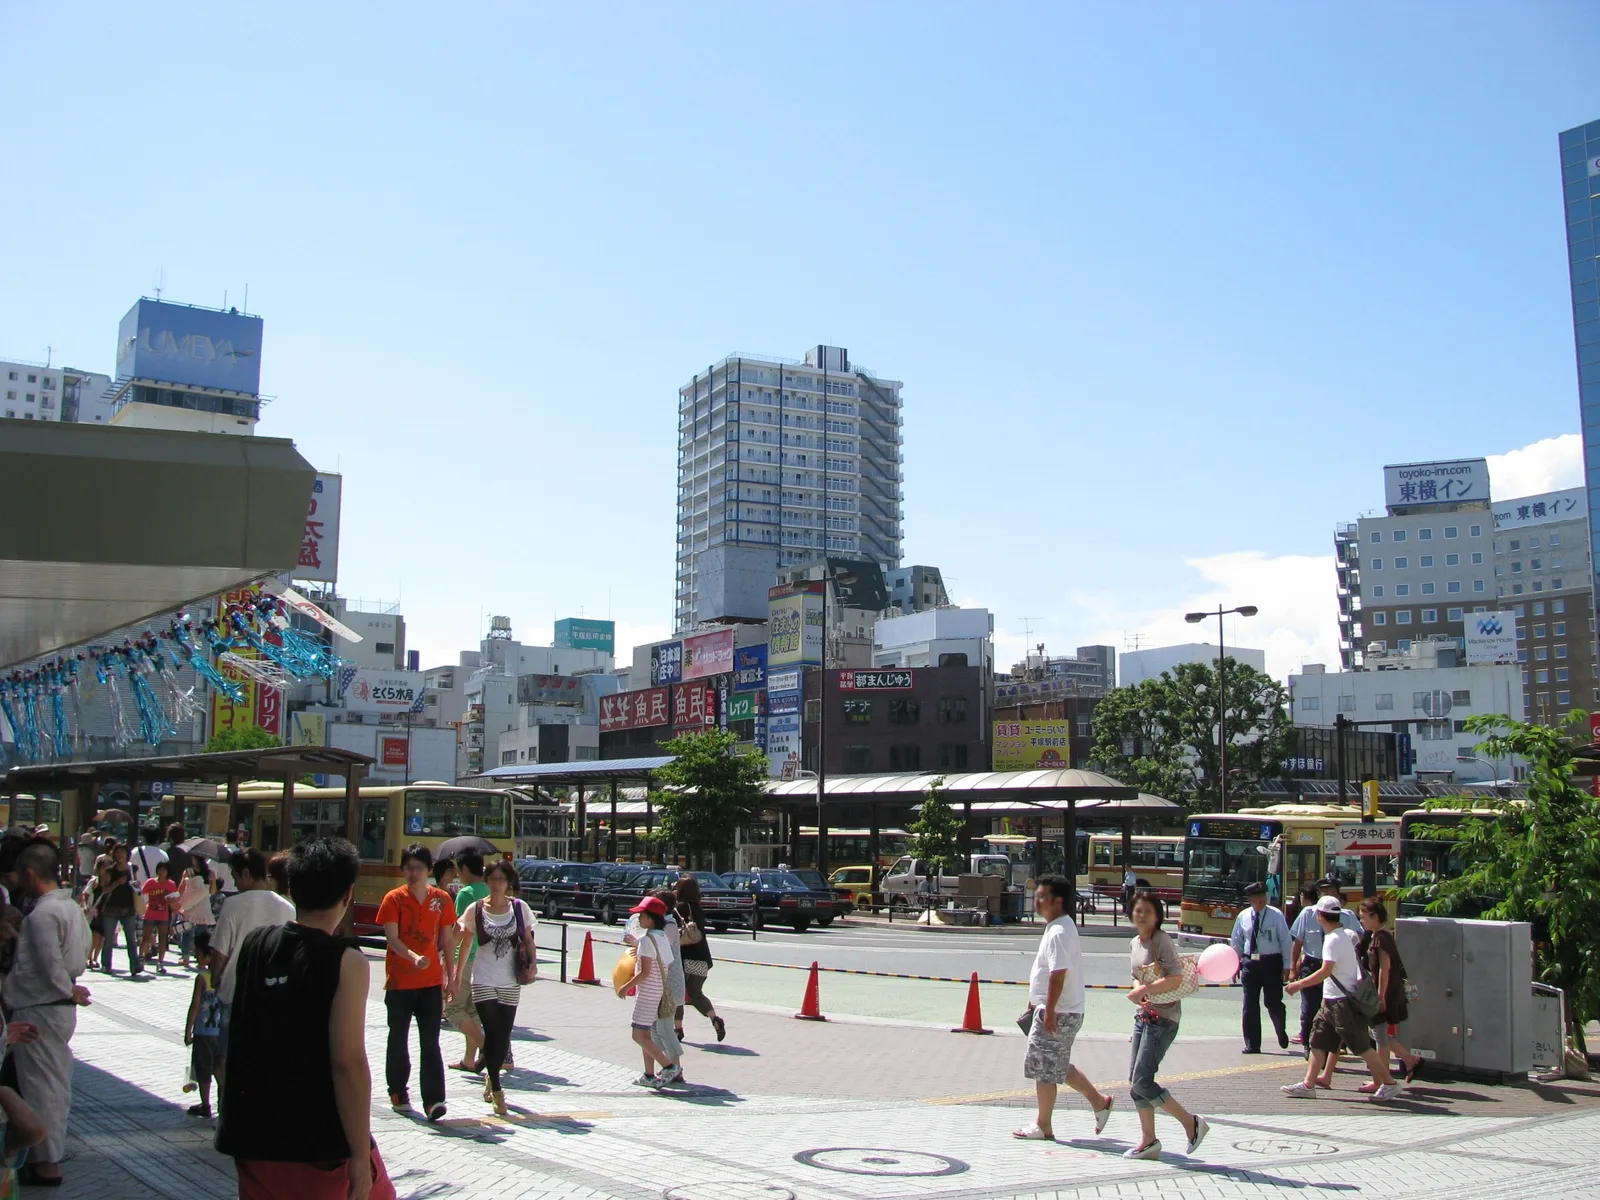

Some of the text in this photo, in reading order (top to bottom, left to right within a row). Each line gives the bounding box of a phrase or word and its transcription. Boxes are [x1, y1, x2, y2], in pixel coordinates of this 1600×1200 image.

[142, 327, 238, 365] UMEYA
[1398, 465, 1472, 479] toyoko-inn.com
[1398, 479, 1473, 502] 東横イン
[1517, 497, 1577, 521] 東横イン
[855, 673, 911, 688] 都まんじゅう
[372, 686, 415, 701] さくら水産
[634, 693, 668, 725] 魚民
[675, 686, 705, 724] 魚民
[730, 699, 748, 716] レイク
[996, 724, 1021, 738] 賃貸
[996, 740, 1027, 748] マンション
[152, 781, 163, 793] 8
[1340, 828, 1395, 840] 七夕祭 中心街
